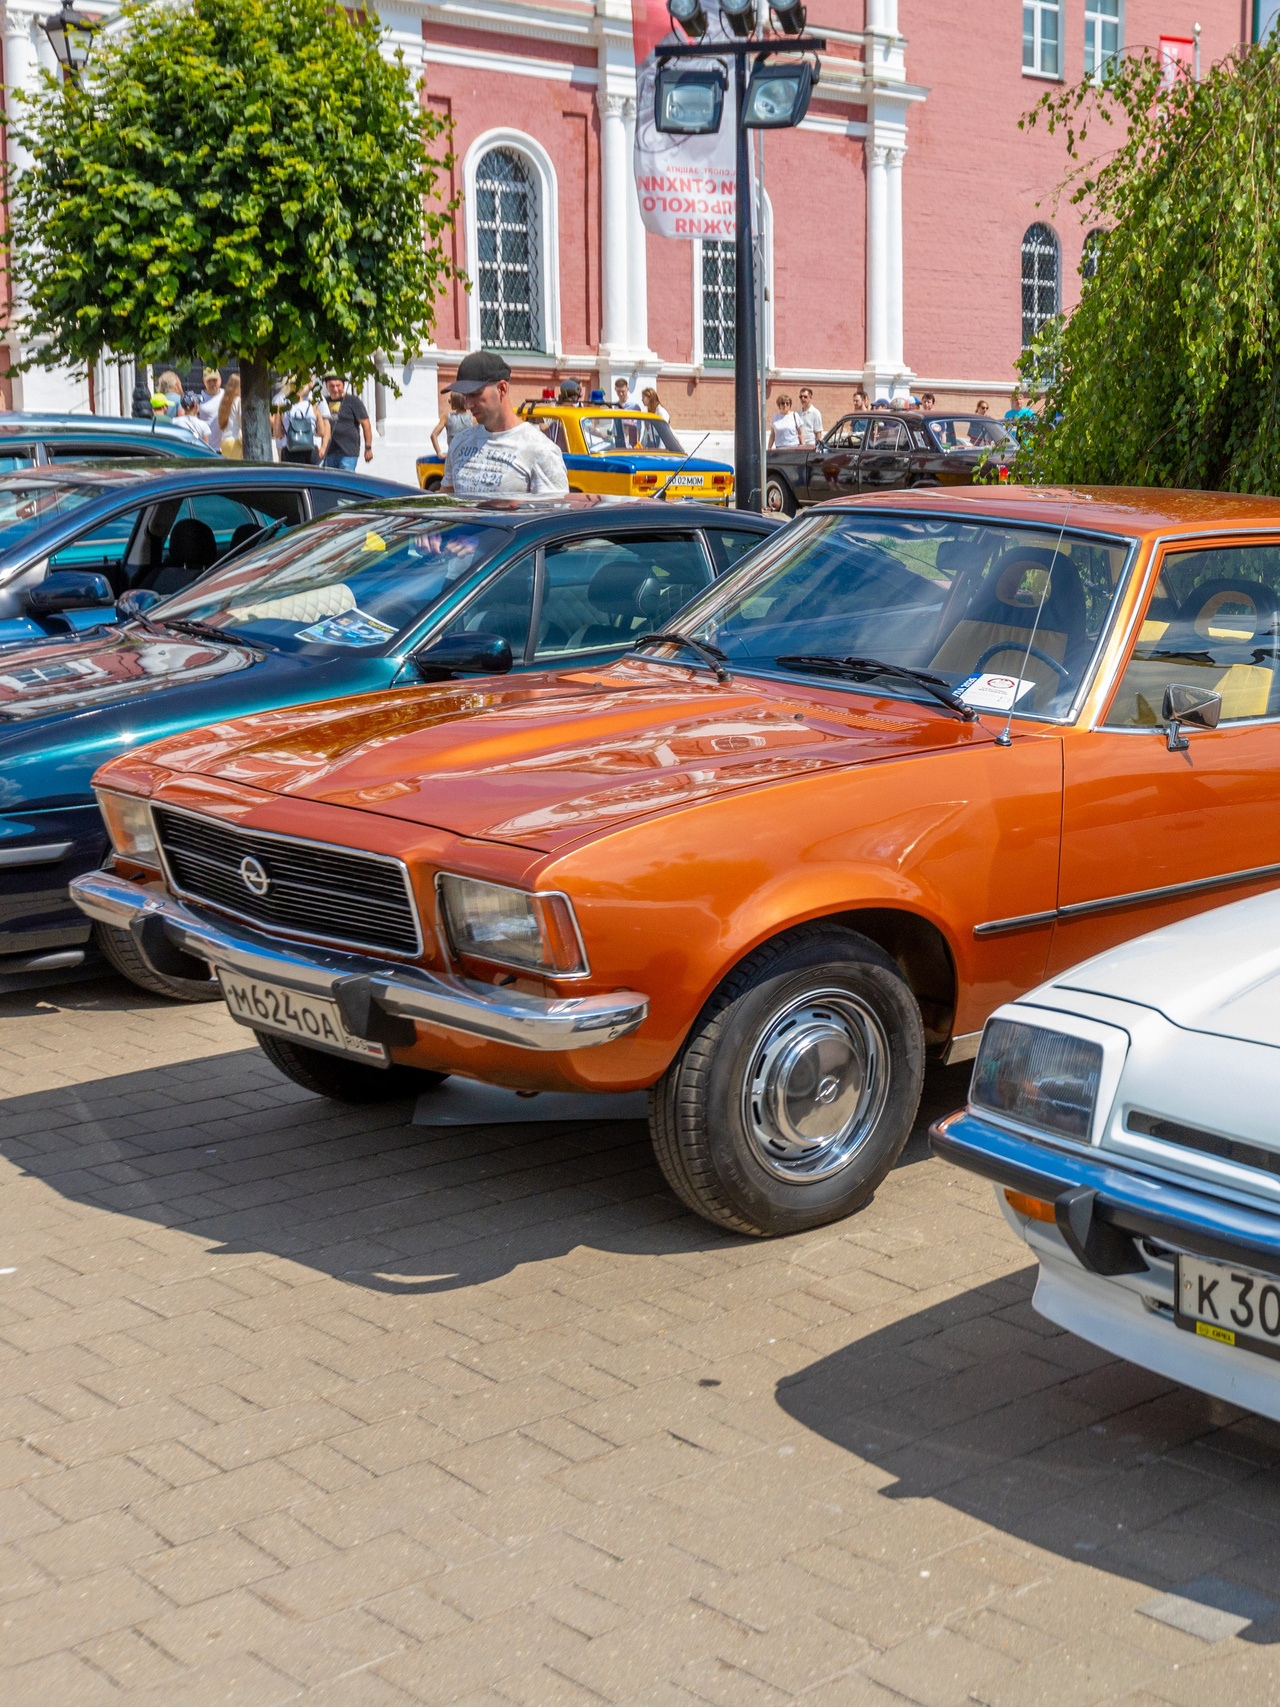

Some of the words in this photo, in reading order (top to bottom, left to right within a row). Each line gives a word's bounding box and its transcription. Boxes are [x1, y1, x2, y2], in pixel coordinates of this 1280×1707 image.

[486, 449, 517, 465] TEAM
[345, 1035, 368, 1050] RUS
[1212, 1329, 1233, 1342] OPEL
